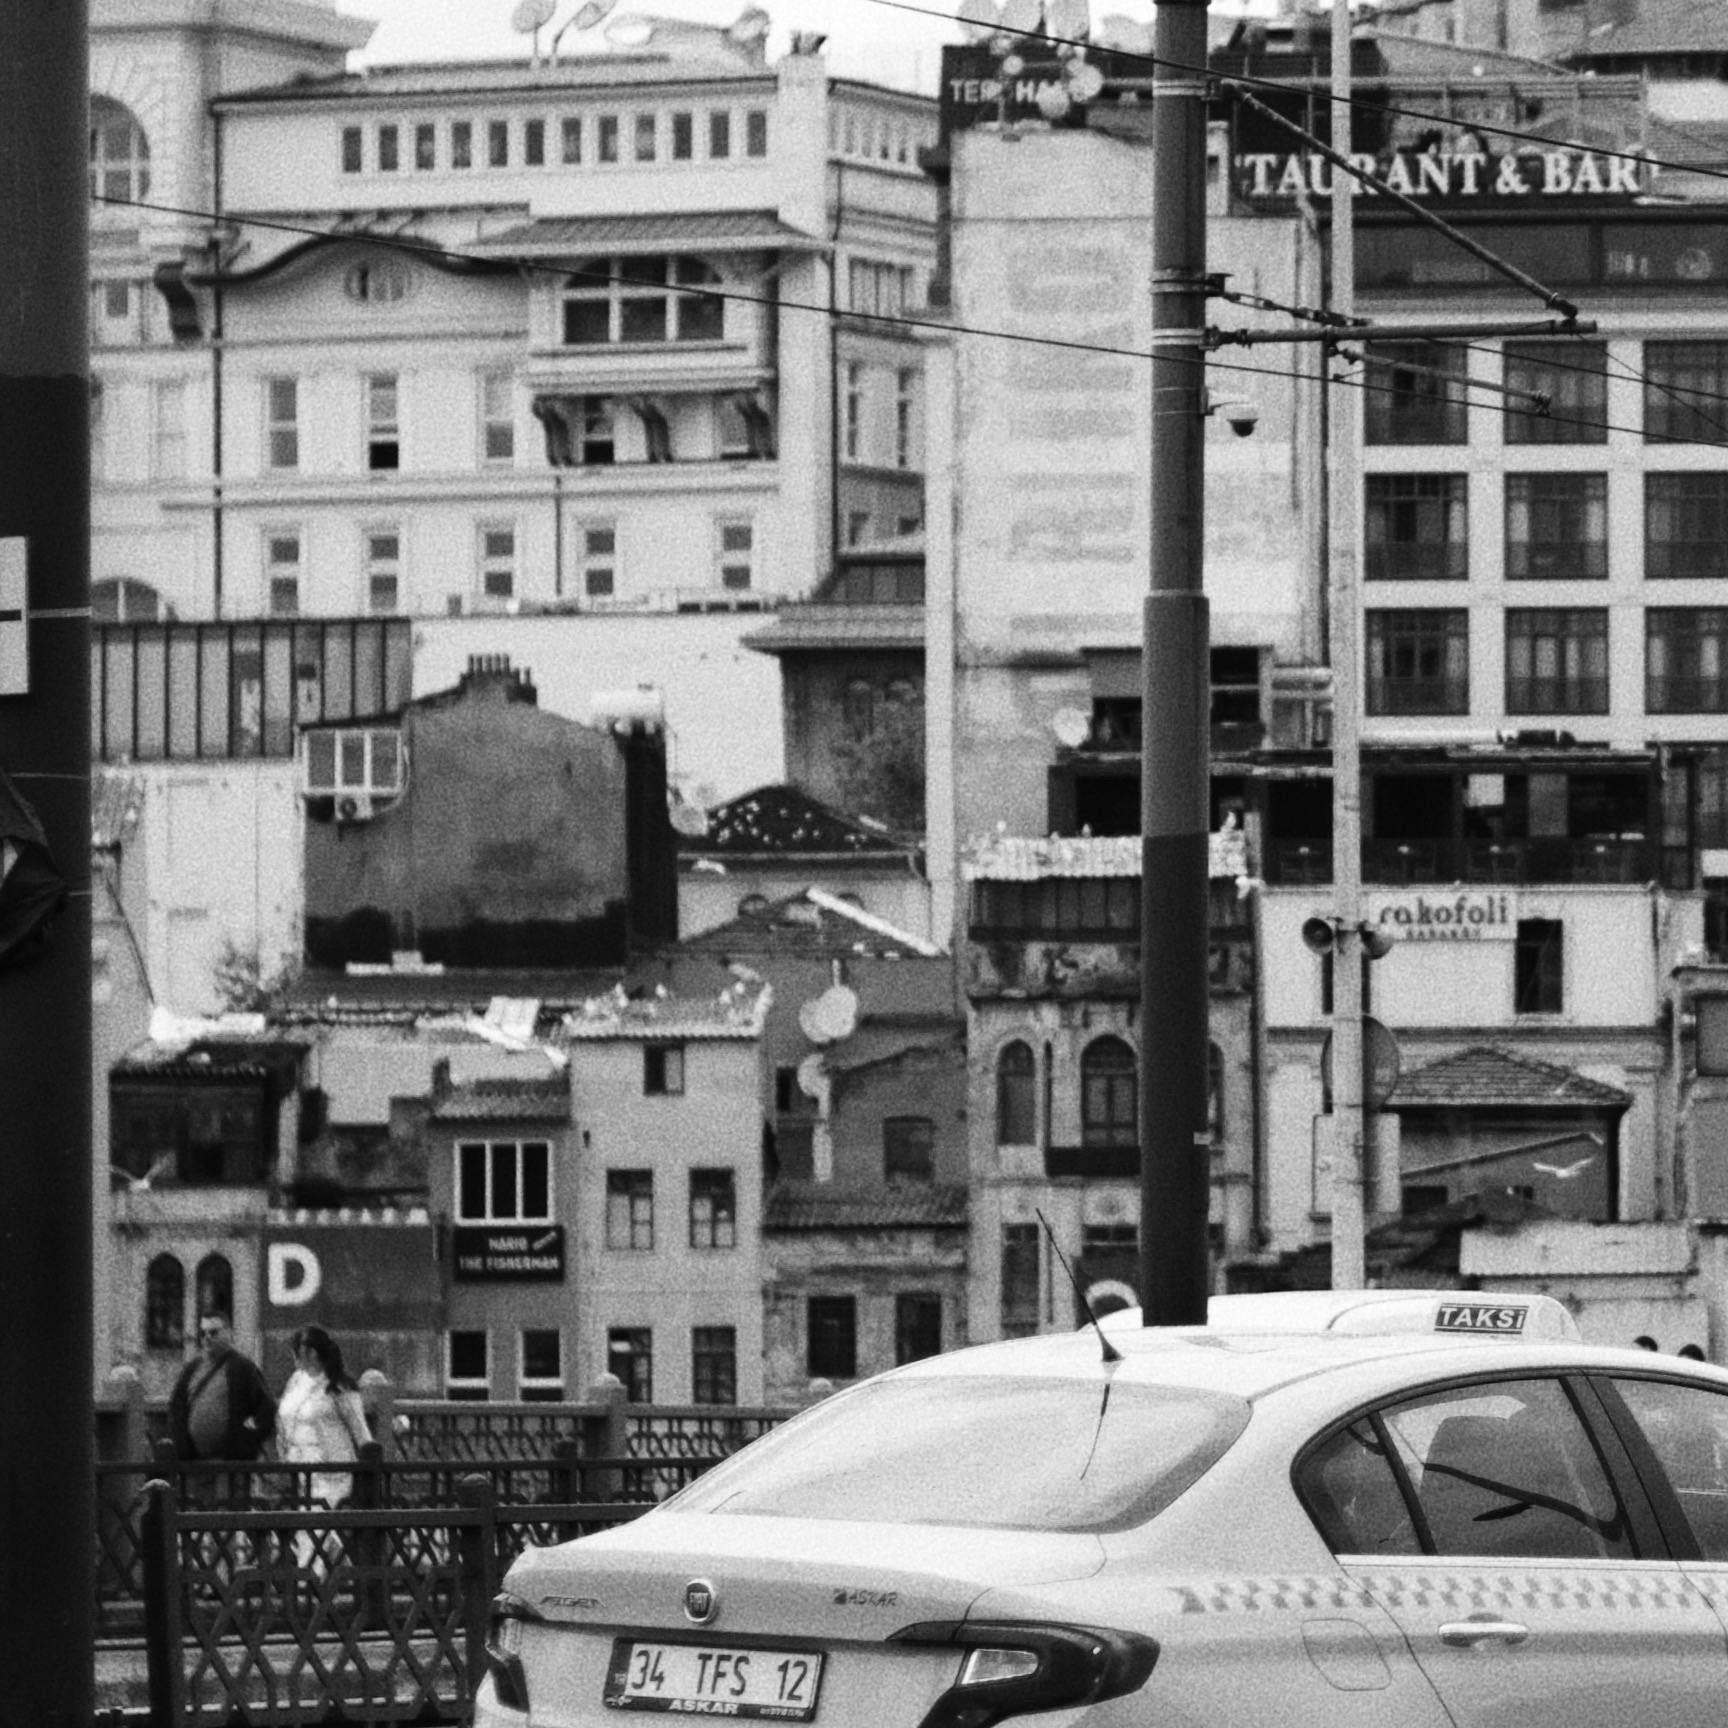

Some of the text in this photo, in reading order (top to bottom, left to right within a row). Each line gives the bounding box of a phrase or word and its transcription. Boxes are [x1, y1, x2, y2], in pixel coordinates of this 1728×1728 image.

[1496, 153, 1530, 194] &
[1542, 151, 1640, 194] BAR
[268, 1242, 321, 1306] D
[631, 1649, 808, 1701] 34 TFS 12
[668, 1698, 739, 1715] ASKAR
